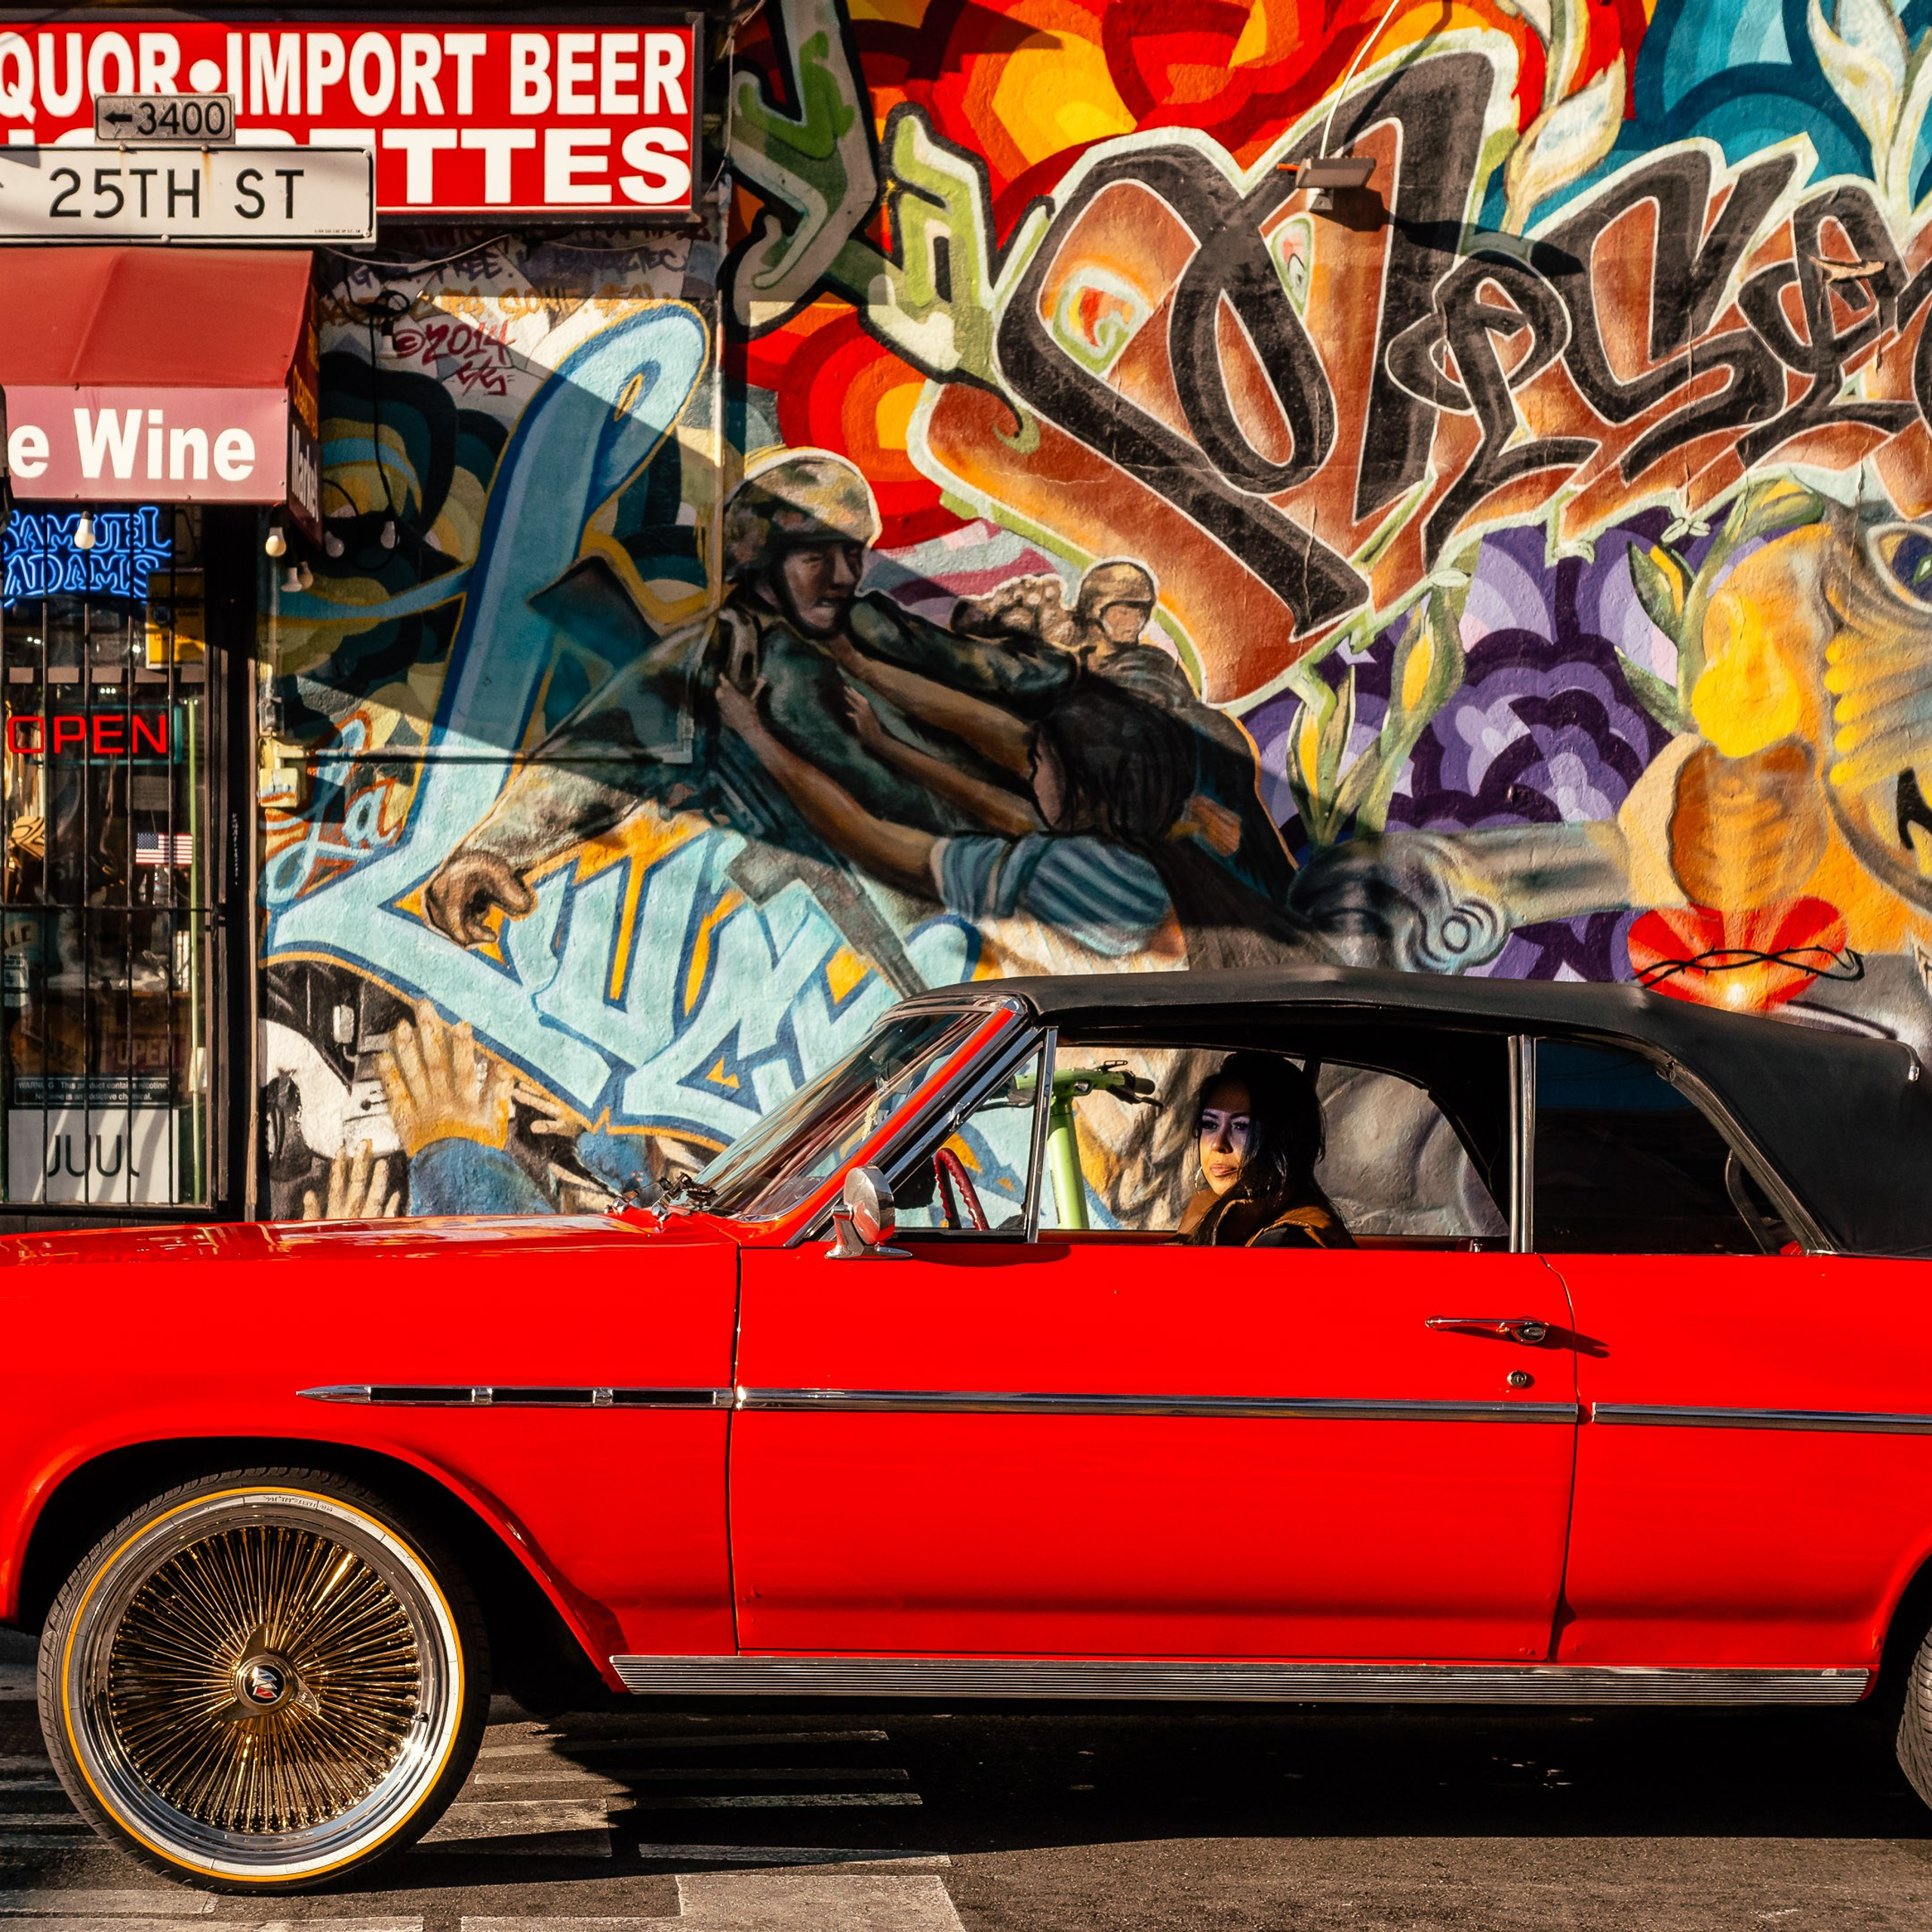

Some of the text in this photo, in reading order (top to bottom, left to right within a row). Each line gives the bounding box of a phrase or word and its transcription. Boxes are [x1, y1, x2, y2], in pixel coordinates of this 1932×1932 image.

[226, 32, 487, 115] IMPORT
[510, 32, 688, 115] BEER
[137, 101, 225, 135] 3400
[49, 168, 304, 219] 25TH ST
[73, 408, 255, 481] Wine
[3, 553, 159, 606] ADAMS
[8, 715, 167, 753] OPEN
[78, 1081, 105, 1091] prduct
